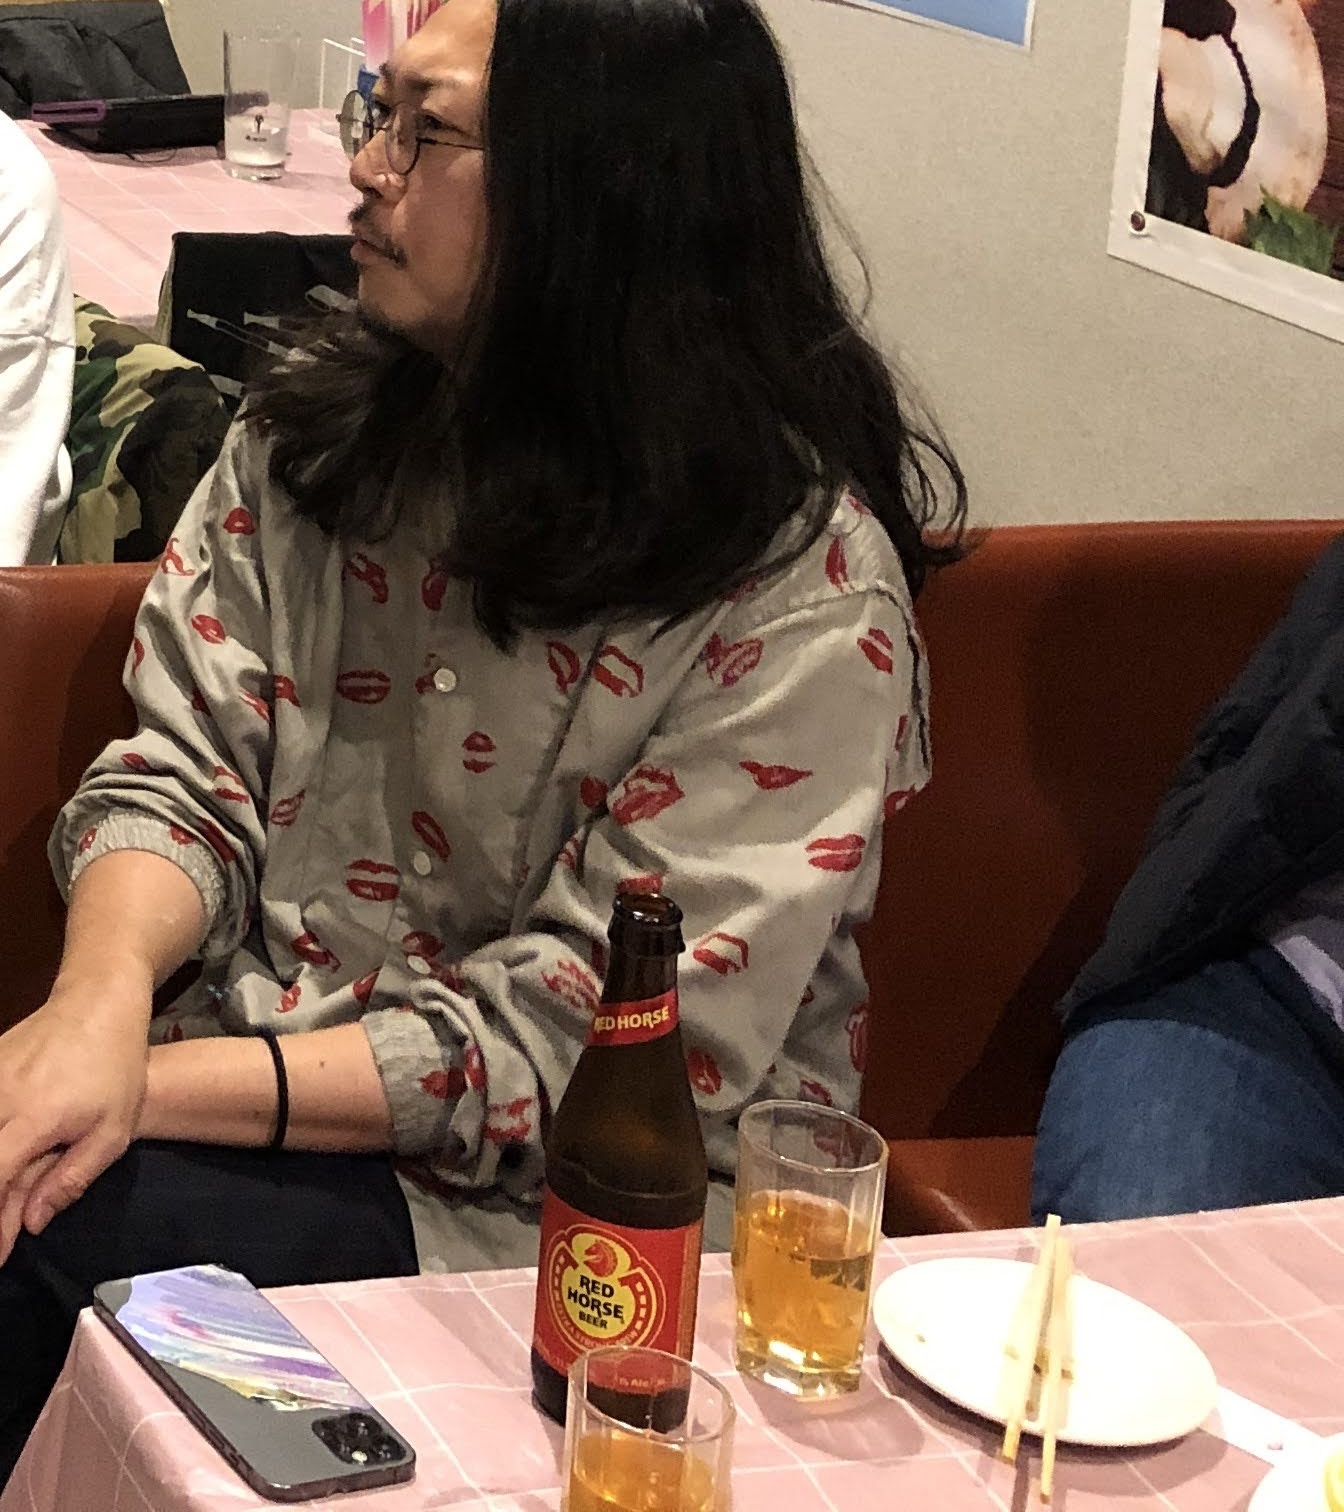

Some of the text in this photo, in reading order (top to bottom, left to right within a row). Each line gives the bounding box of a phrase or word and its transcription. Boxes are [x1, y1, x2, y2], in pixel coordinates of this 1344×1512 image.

[617, 1005, 669, 1031] HORSE
[579, 1274, 615, 1299] RED
[567, 1286, 625, 1325] HORSE
[578, 1311, 608, 1330] BEER
